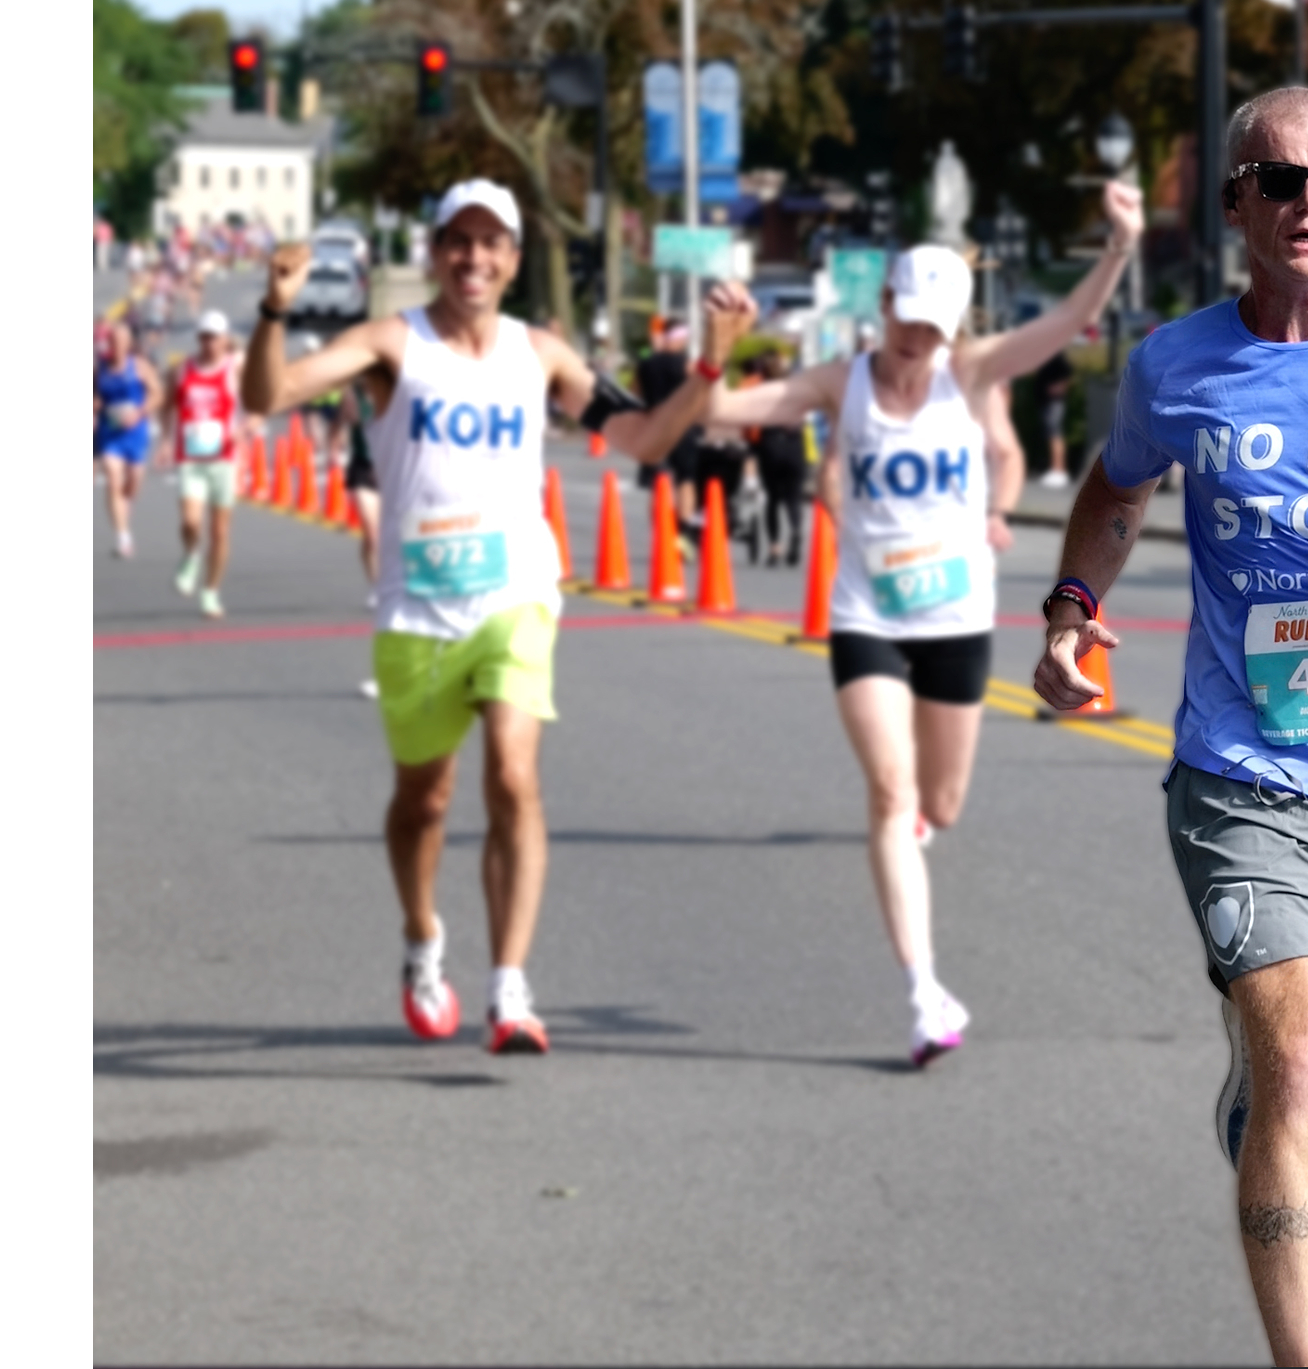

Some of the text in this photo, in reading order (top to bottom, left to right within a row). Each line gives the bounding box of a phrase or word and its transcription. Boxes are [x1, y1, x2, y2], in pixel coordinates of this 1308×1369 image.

[409, 397, 525, 448] KOH
[1193, 423, 1284, 474] NO
[850, 446, 970, 499] KOH
[424, 539, 487, 567] 972
[895, 566, 947, 597] 971
[1273, 604, 1308, 620] North
